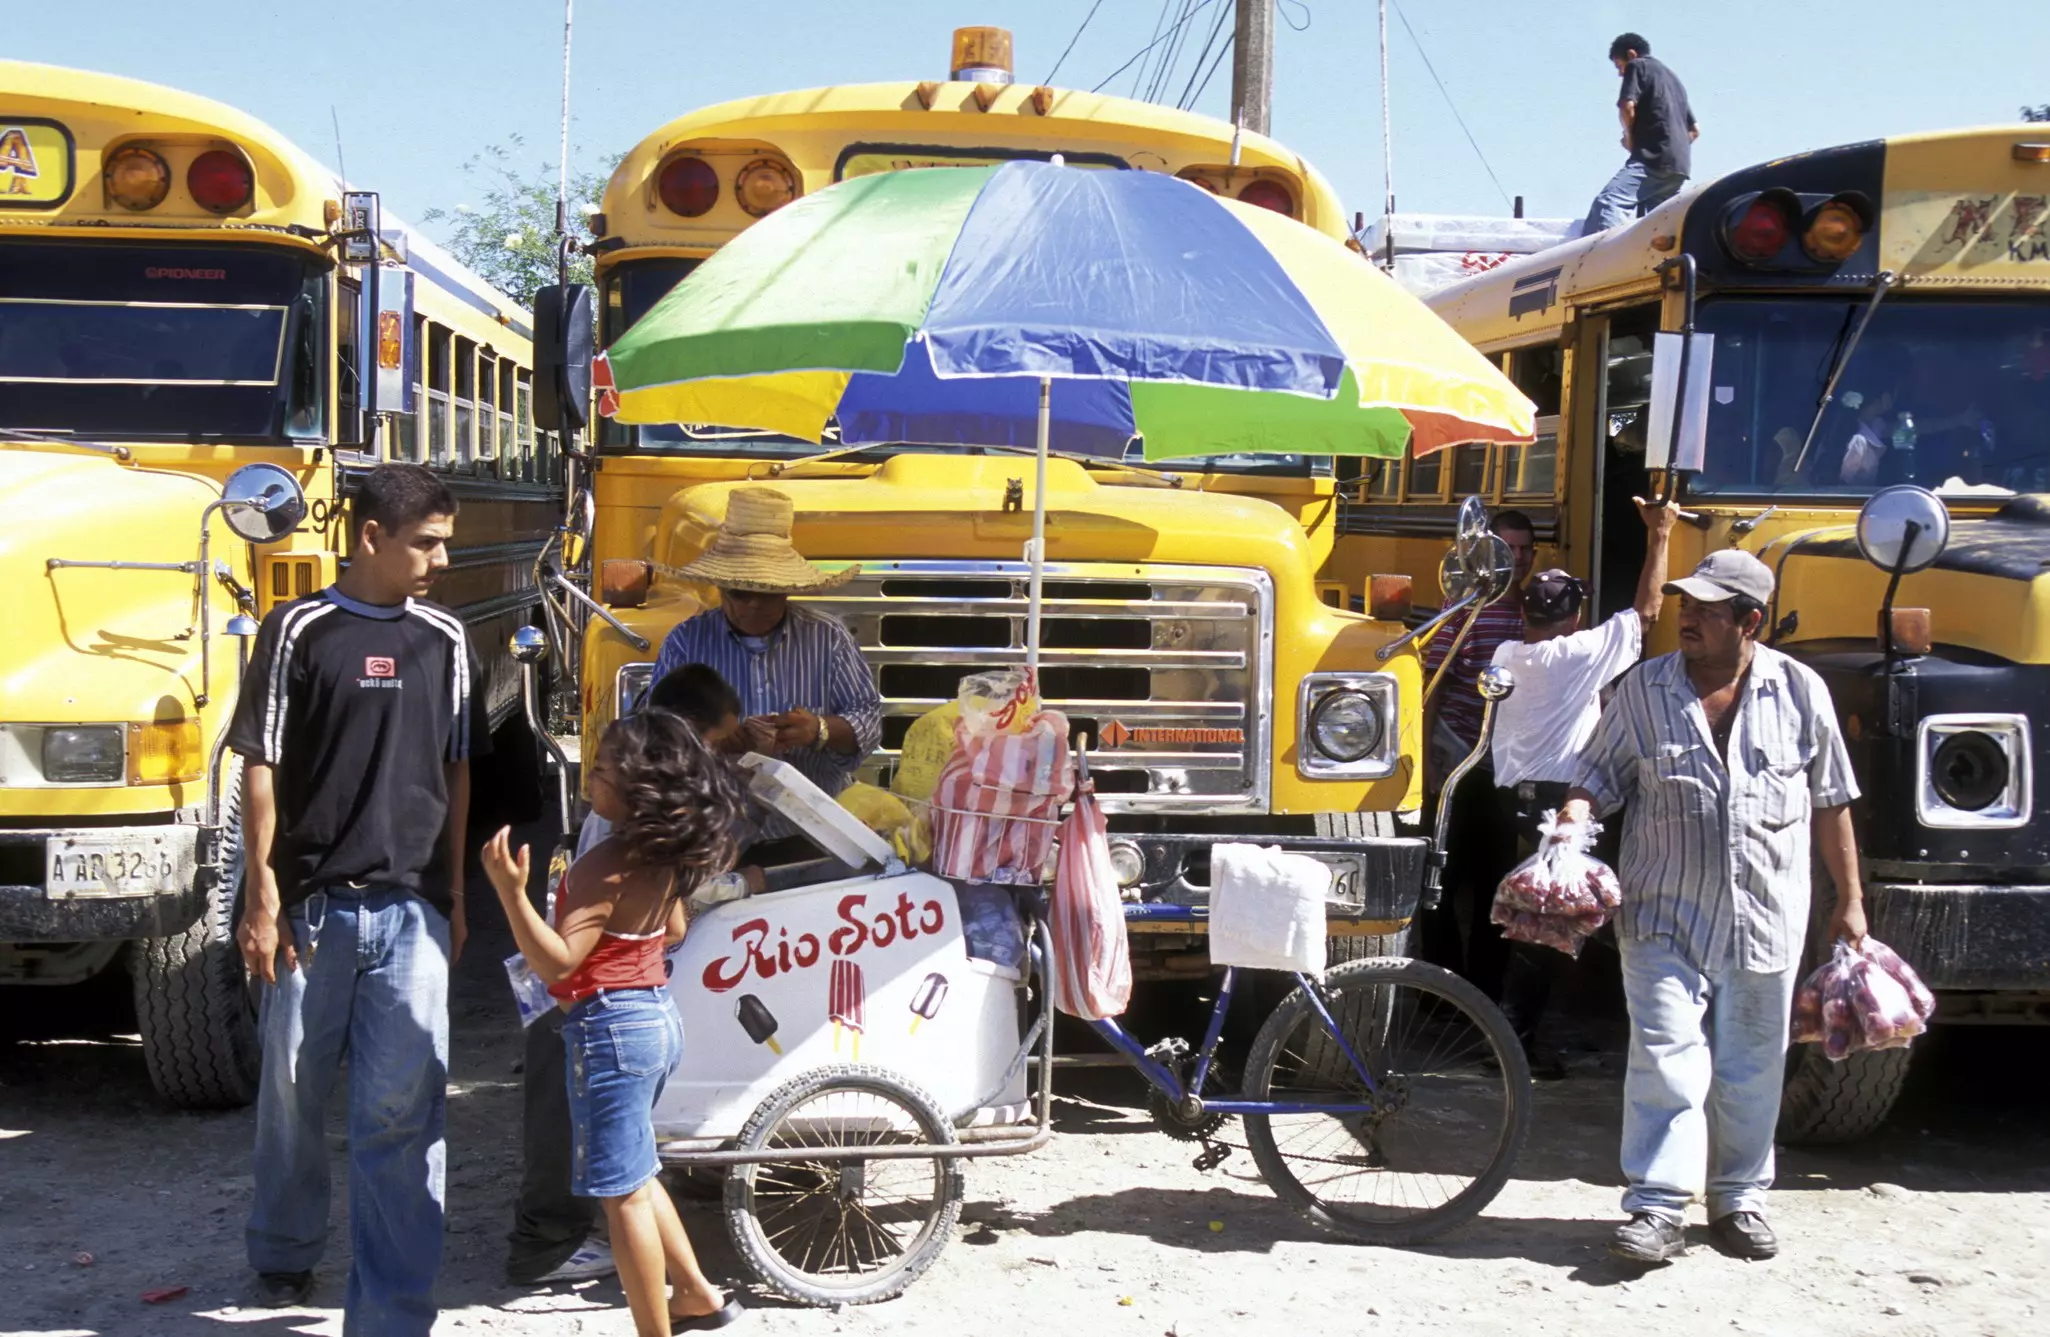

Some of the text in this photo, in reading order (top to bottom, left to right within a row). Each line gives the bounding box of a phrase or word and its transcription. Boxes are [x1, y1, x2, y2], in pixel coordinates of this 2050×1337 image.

[158, 267, 226, 280] PIONEER
[1133, 727, 1245, 743] INTERNATIONAL
[702, 892, 944, 993] Rio Soto
